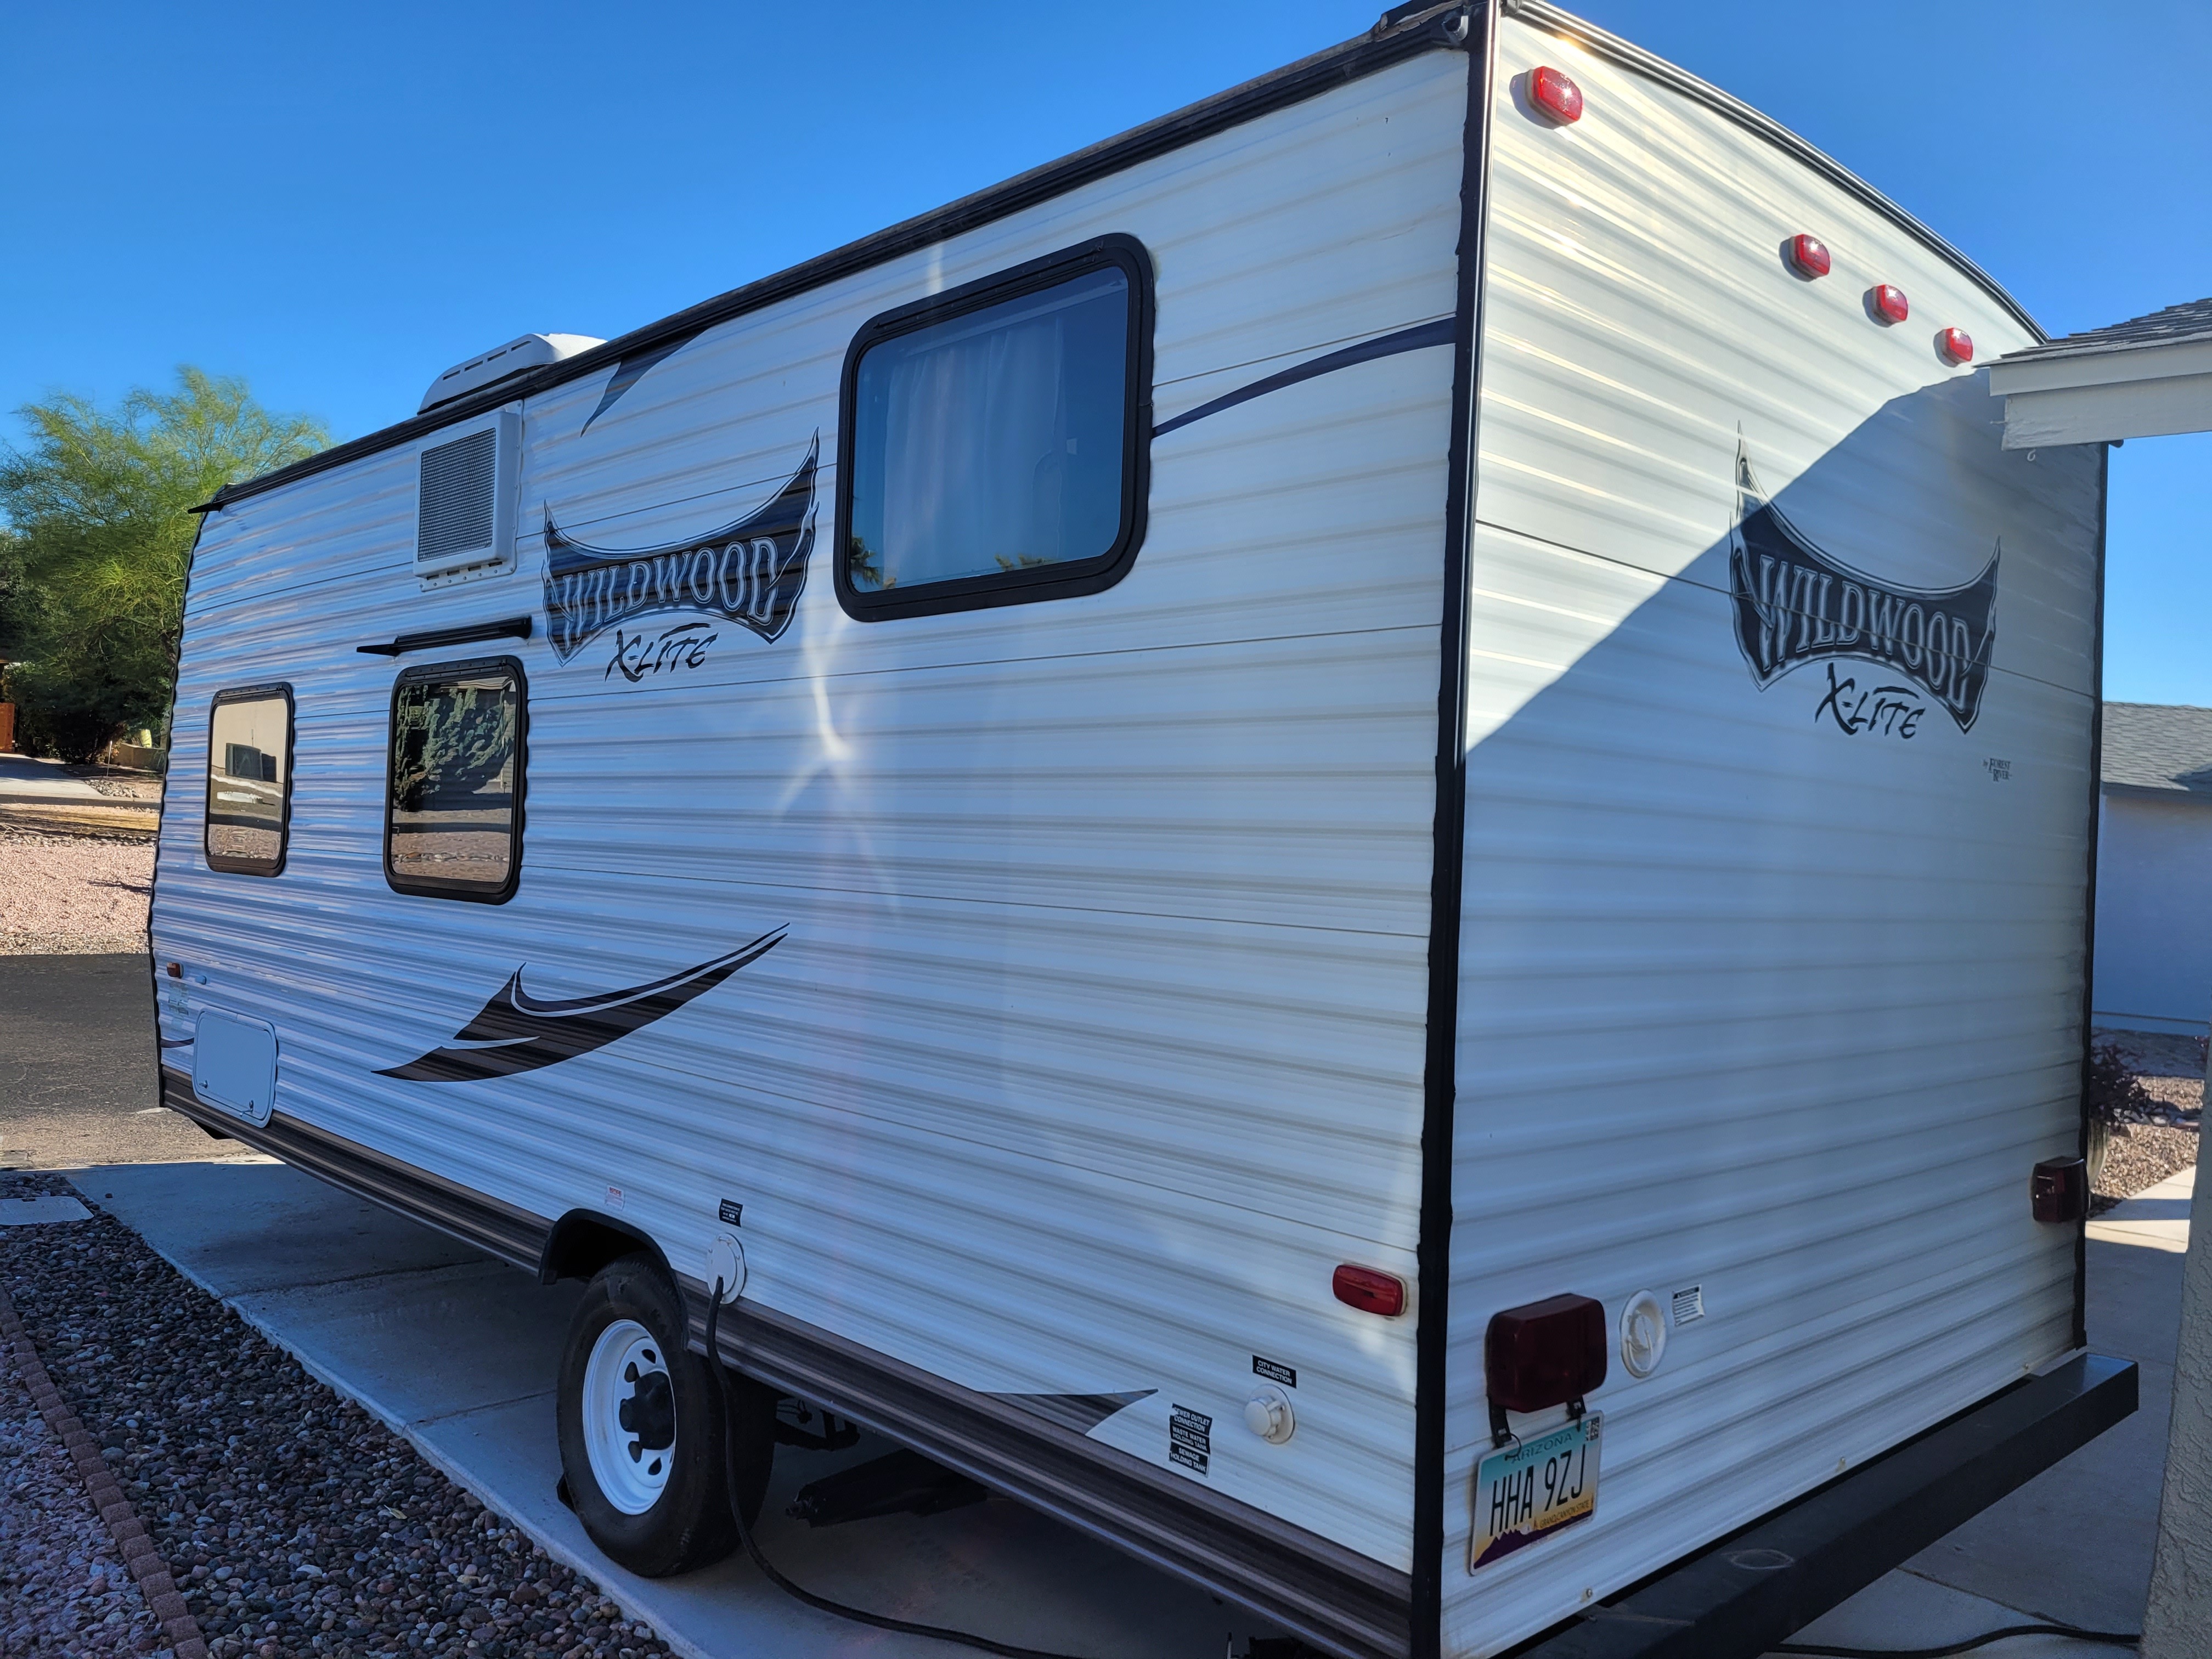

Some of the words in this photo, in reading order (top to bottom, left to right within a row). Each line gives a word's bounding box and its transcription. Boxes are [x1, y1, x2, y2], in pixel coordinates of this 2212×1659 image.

[562, 537, 779, 653] WILDWOOD
[1759, 554, 1971, 713] WILDWOOD
[605, 622, 719, 683] X-LITE
[1815, 662, 1926, 739] X-LITE
[1256, 1366, 1293, 1384] CONNECTION
[1257, 1360, 1271, 1369] CITY
[1271, 1364, 1290, 1377] WATER
[1174, 1415, 1205, 1432] CONNECTION
[1190, 1414, 1210, 1426] OUTLET
[1172, 1425, 1189, 1437] WASTE
[1189, 1432, 1206, 1444] WATER
[1172, 1432, 1194, 1446] HOLDING
[1194, 1441, 1207, 1451] TANK
[1178, 1447, 1200, 1462] SEWAGE
[1511, 1432, 1572, 1464] ARIZONA
[1170, 1452, 1193, 1466] HOLDING
[1193, 1461, 1206, 1473] TANK
[1489, 1465, 1534, 1537] HHA
[1544, 1443, 1586, 1513] 9ZJ
